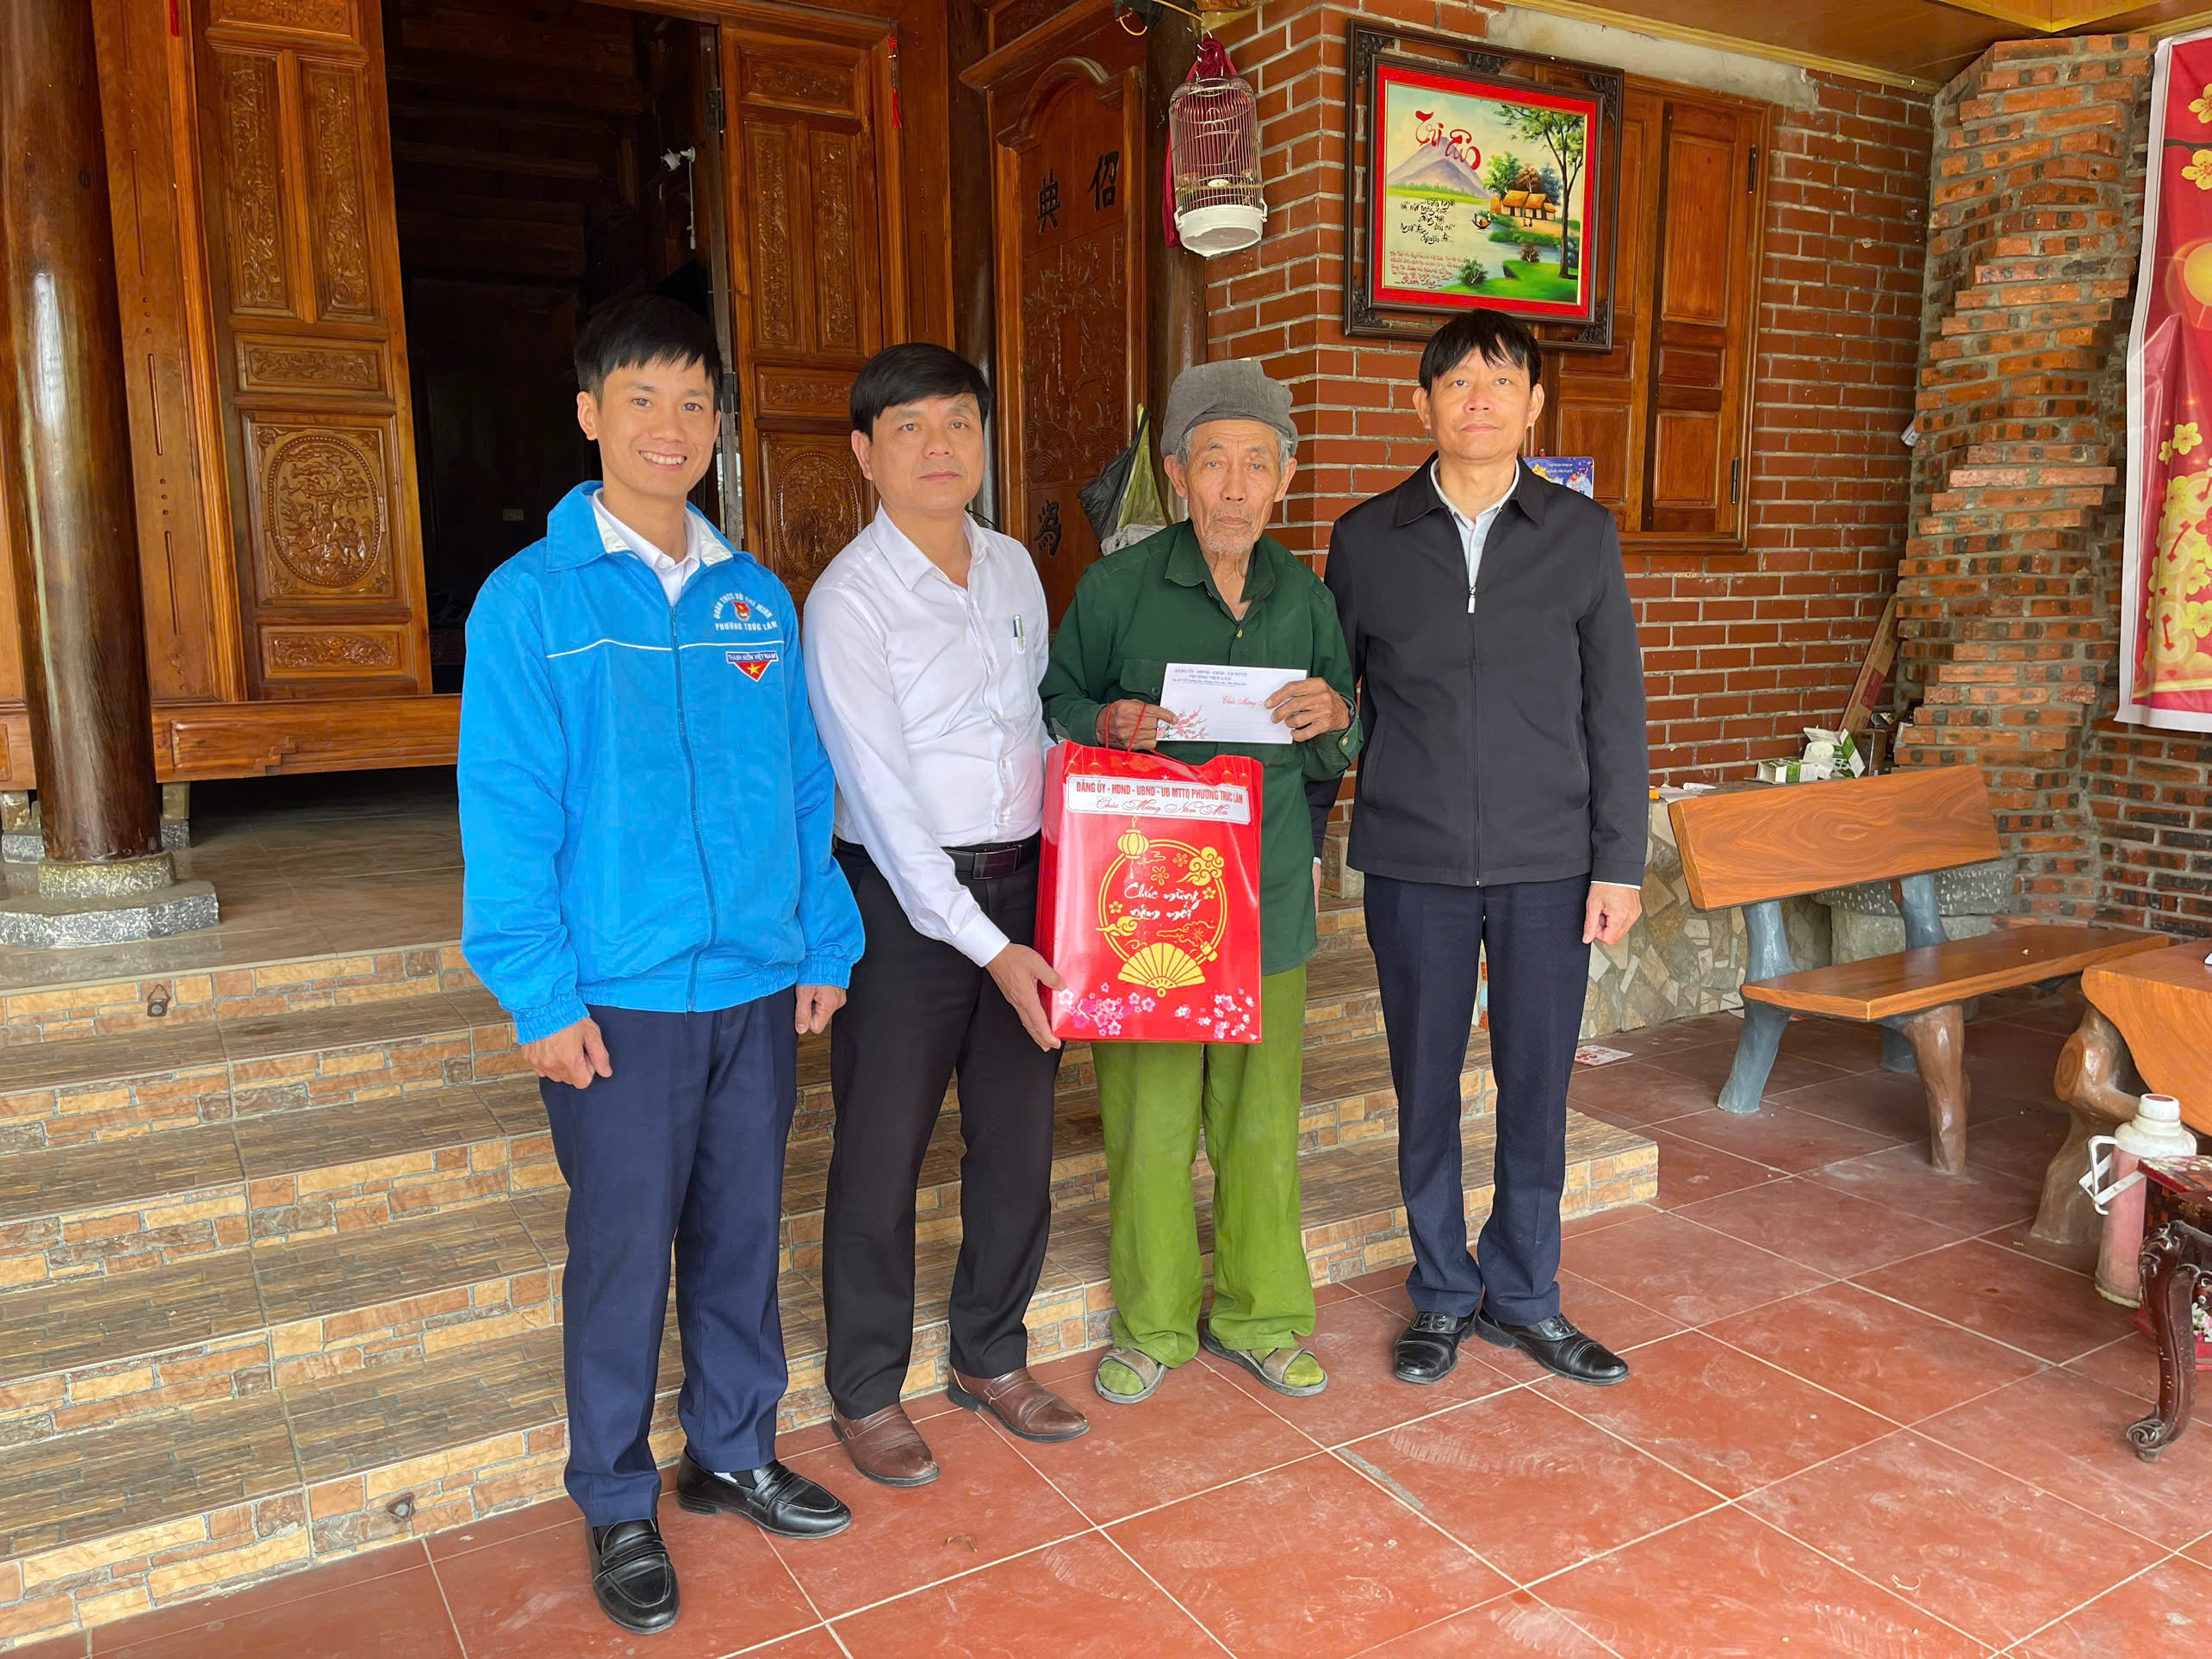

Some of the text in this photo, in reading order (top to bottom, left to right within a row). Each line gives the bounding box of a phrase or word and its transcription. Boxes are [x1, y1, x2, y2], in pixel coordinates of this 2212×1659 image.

[1415, 109, 1445, 148] Tri
[1076, 779, 1096, 792] ĐẢNG
[1097, 780, 1106, 793] ỦY
[1136, 786, 1156, 796] UBND
[1161, 786, 1170, 797] UB
[1171, 787, 1190, 799] MTTQ
[1097, 795, 1119, 810] Chúc
[1124, 881, 1202, 910] Chúc mừng
[1166, 901, 1192, 922] mới
